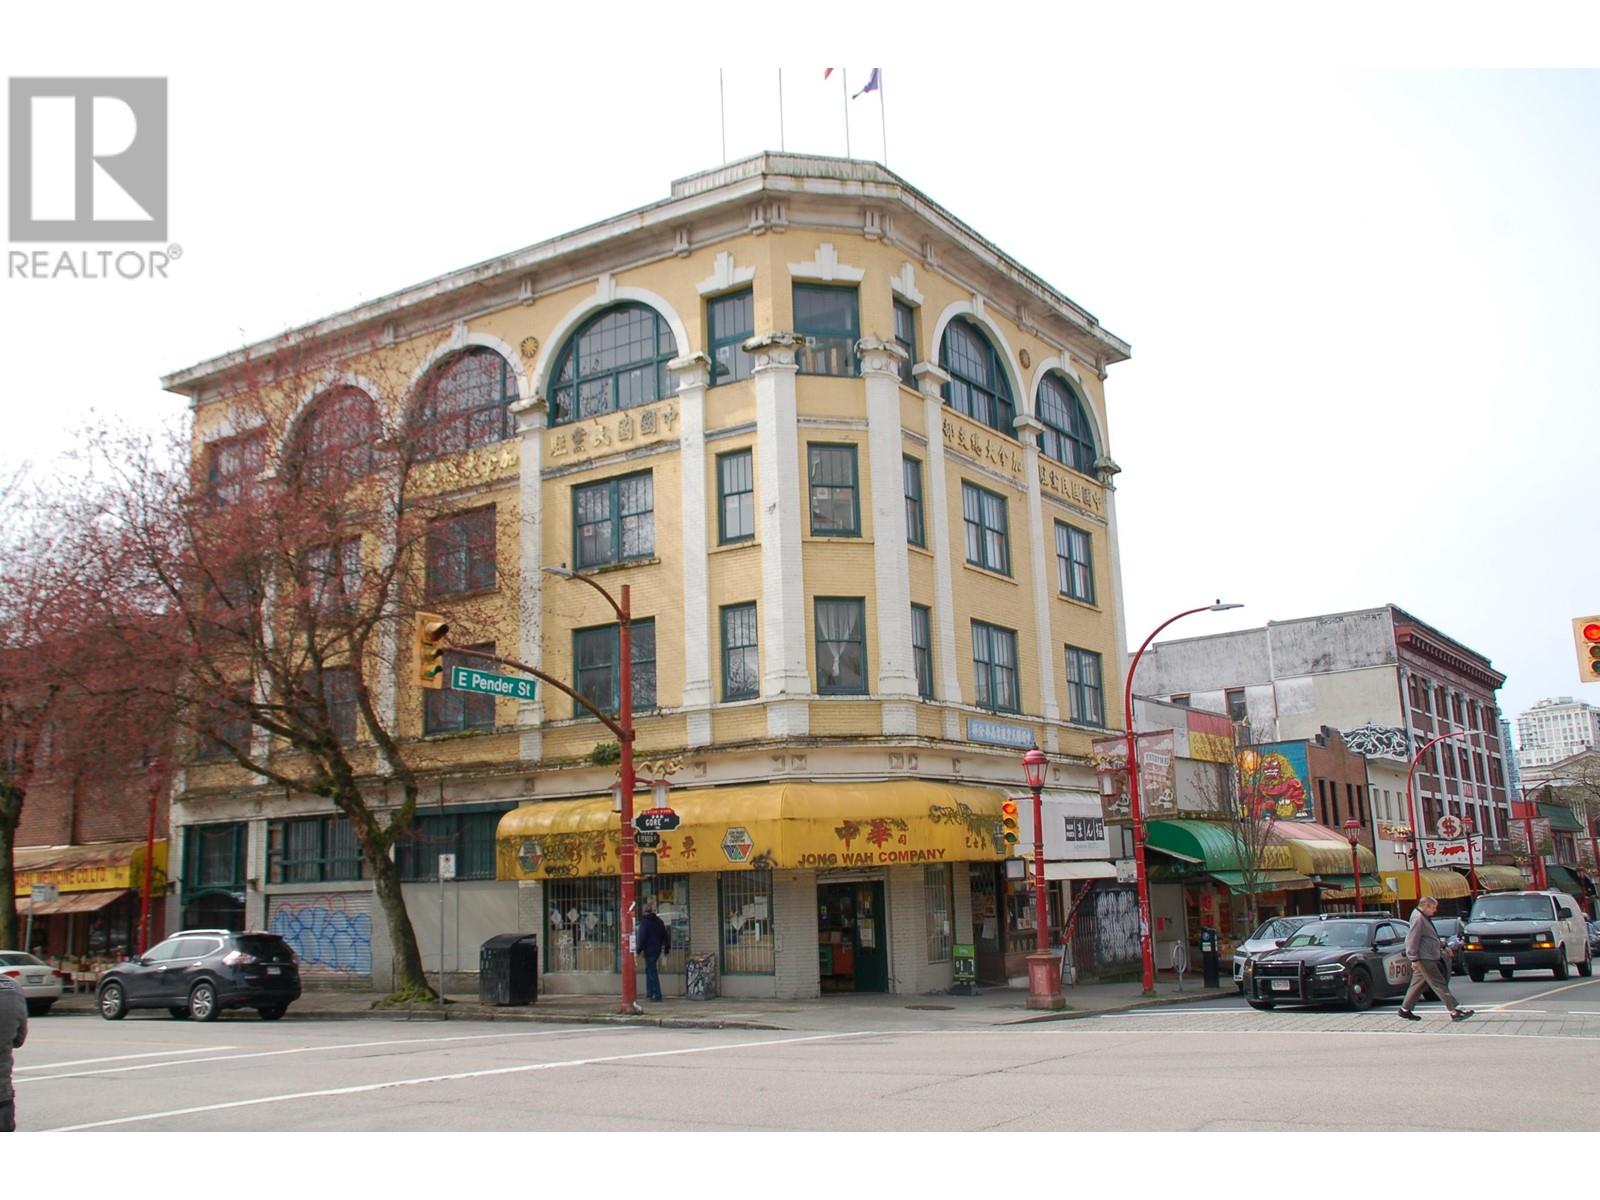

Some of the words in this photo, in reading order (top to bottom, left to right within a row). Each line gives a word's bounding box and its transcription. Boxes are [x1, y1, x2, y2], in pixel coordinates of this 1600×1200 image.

[458, 671, 468, 687] E
[472, 673, 514, 694] Pender
[517, 682, 531, 697] St
[645, 818, 662, 827] GORE
[799, 853, 838, 866] JONG
[842, 853, 874, 865] WAH
[878, 848, 946, 863] COMPANY
